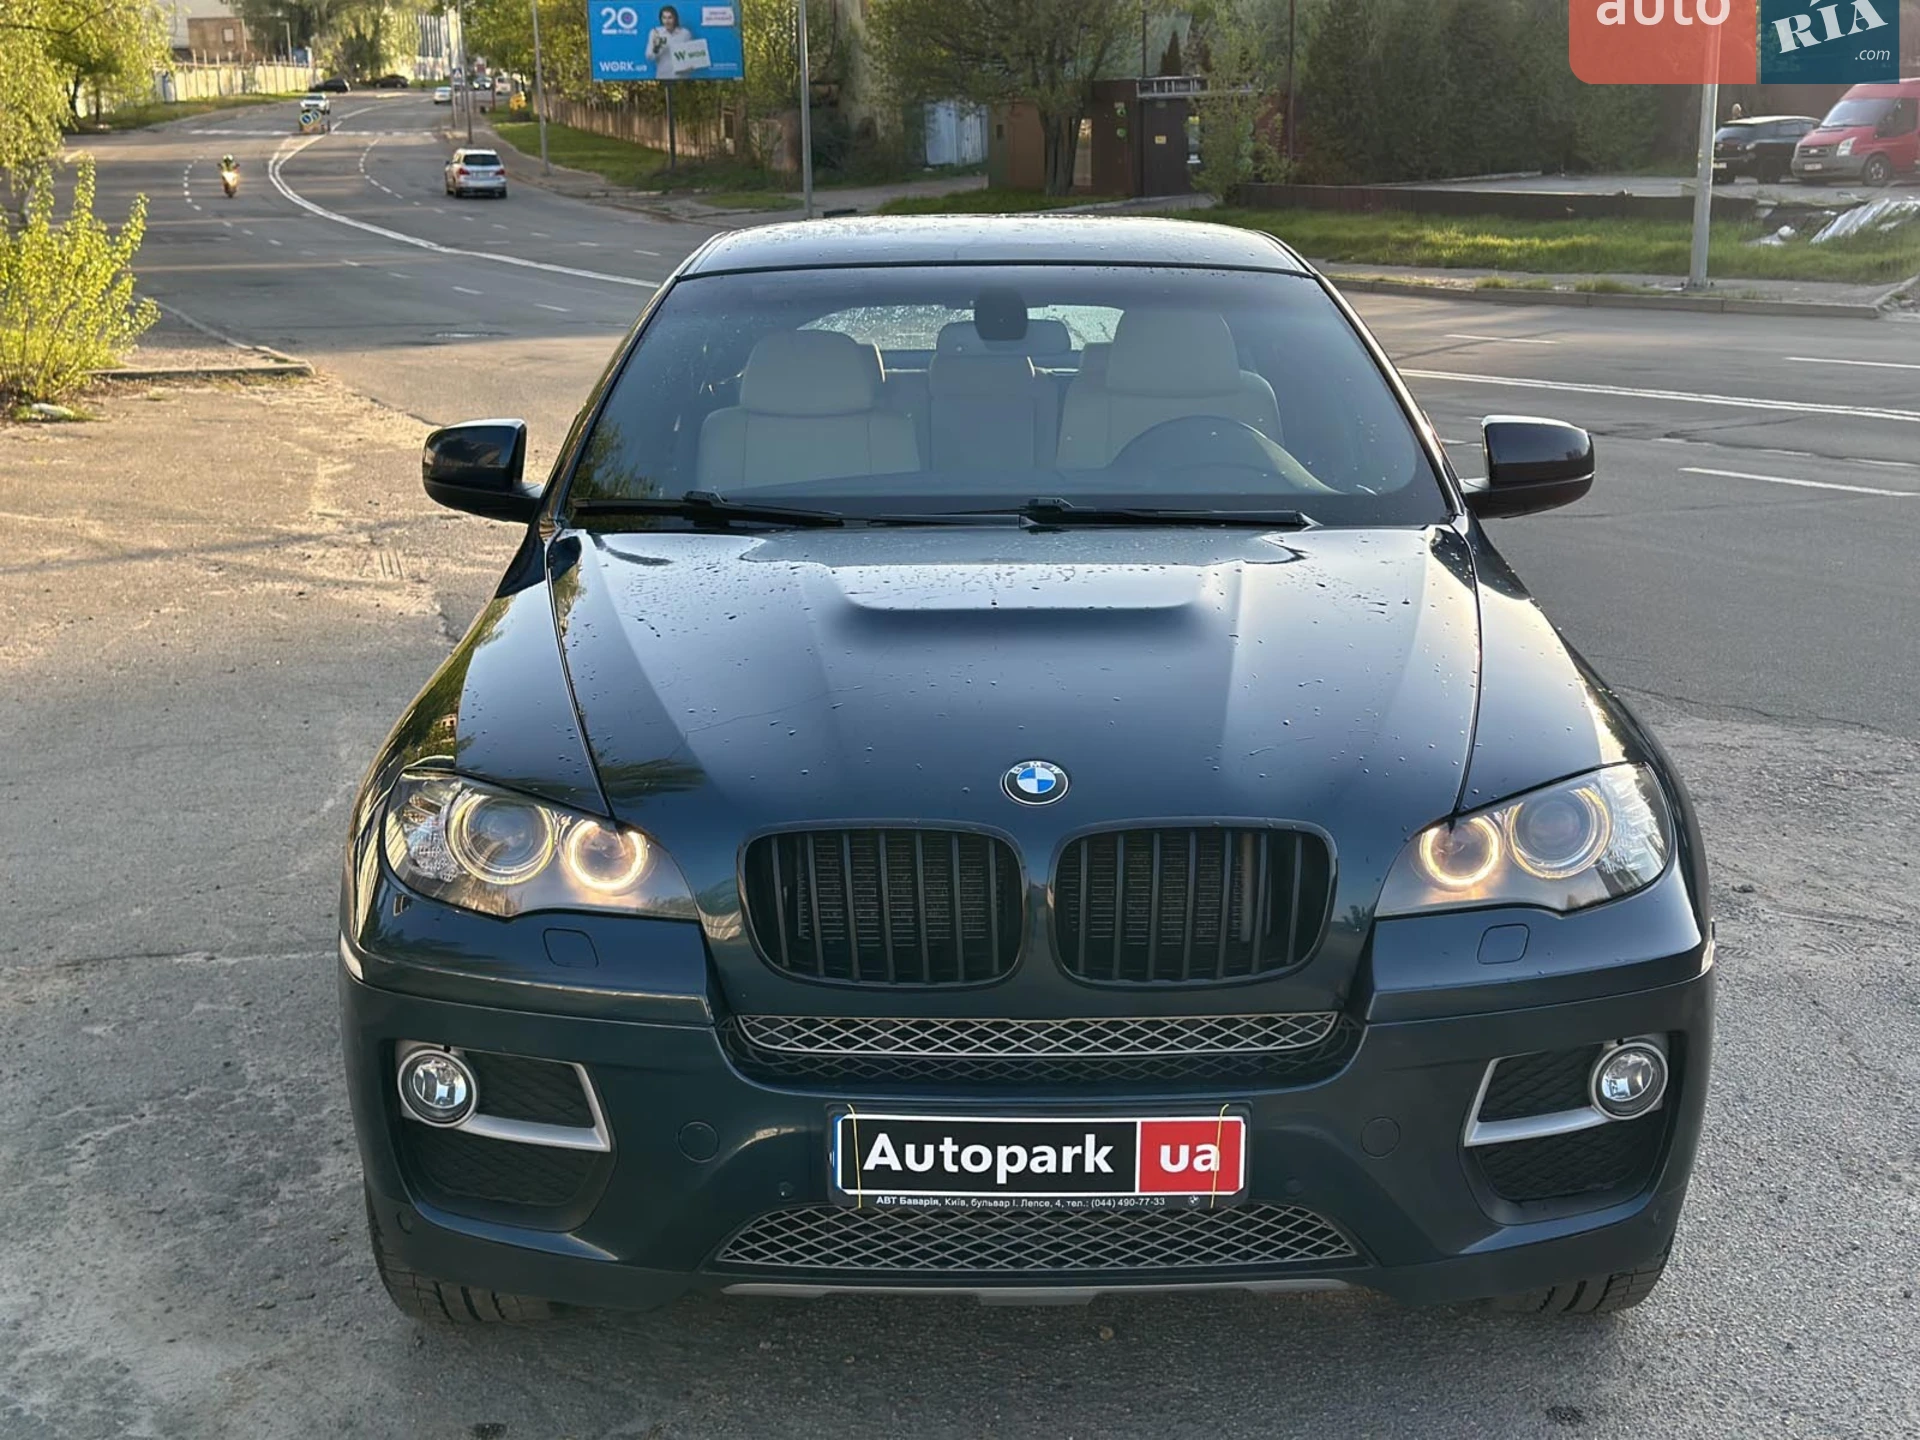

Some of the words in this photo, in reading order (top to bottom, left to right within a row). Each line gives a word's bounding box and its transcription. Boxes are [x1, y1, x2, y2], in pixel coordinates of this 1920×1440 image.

[601, 7, 638, 29] 20
[862, 1133, 1115, 1184] Autopark
[1159, 1143, 1221, 1172] ua
[899, 1196, 942, 1207] Баварія,
[945, 1197, 969, 1208] Київ,
[970, 1198, 1011, 1208] бульвар
[1020, 1199, 1054, 1209] Лепсе,
[1055, 1199, 1065, 1209] 4,
[1091, 1198, 1116, 1208] (044)
[1118, 1197, 1166, 1207] 490-77-33
